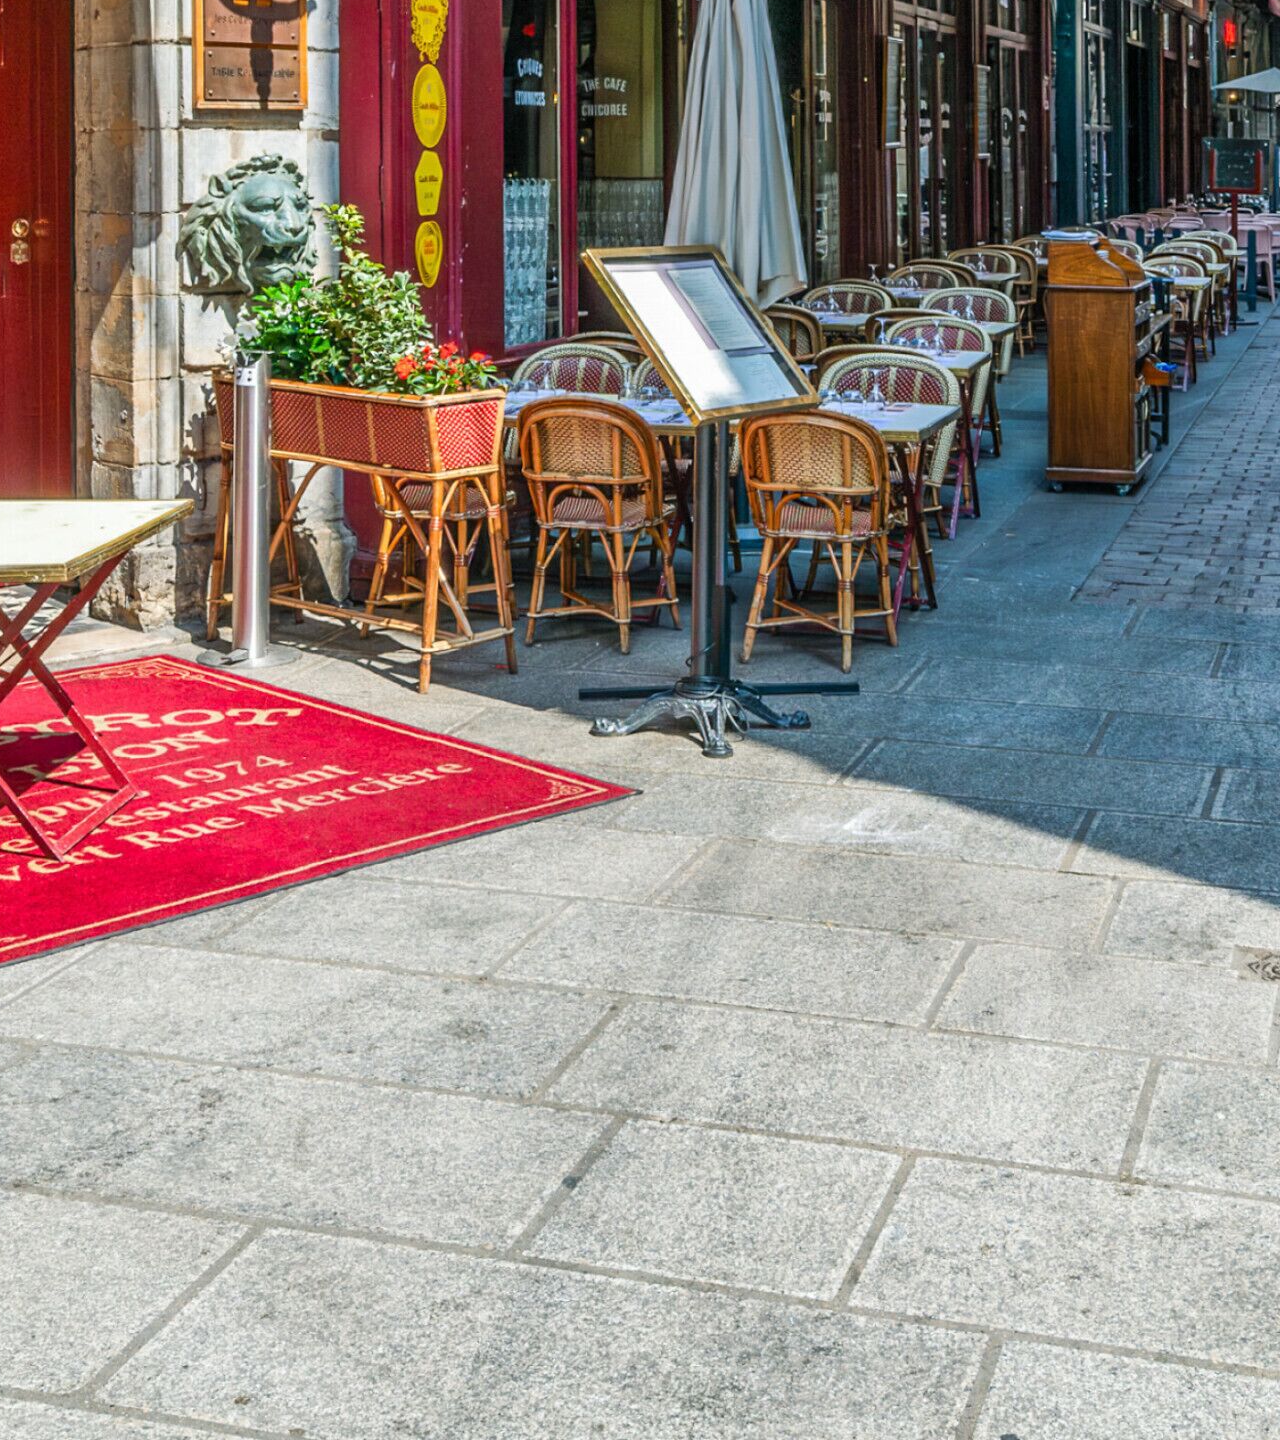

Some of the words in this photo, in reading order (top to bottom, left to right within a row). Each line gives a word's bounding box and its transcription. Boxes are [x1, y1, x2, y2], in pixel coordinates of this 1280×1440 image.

[154, 754, 293, 790] 1974
[118, 813, 246, 851] Rue
[239, 759, 473, 819] Mercière
